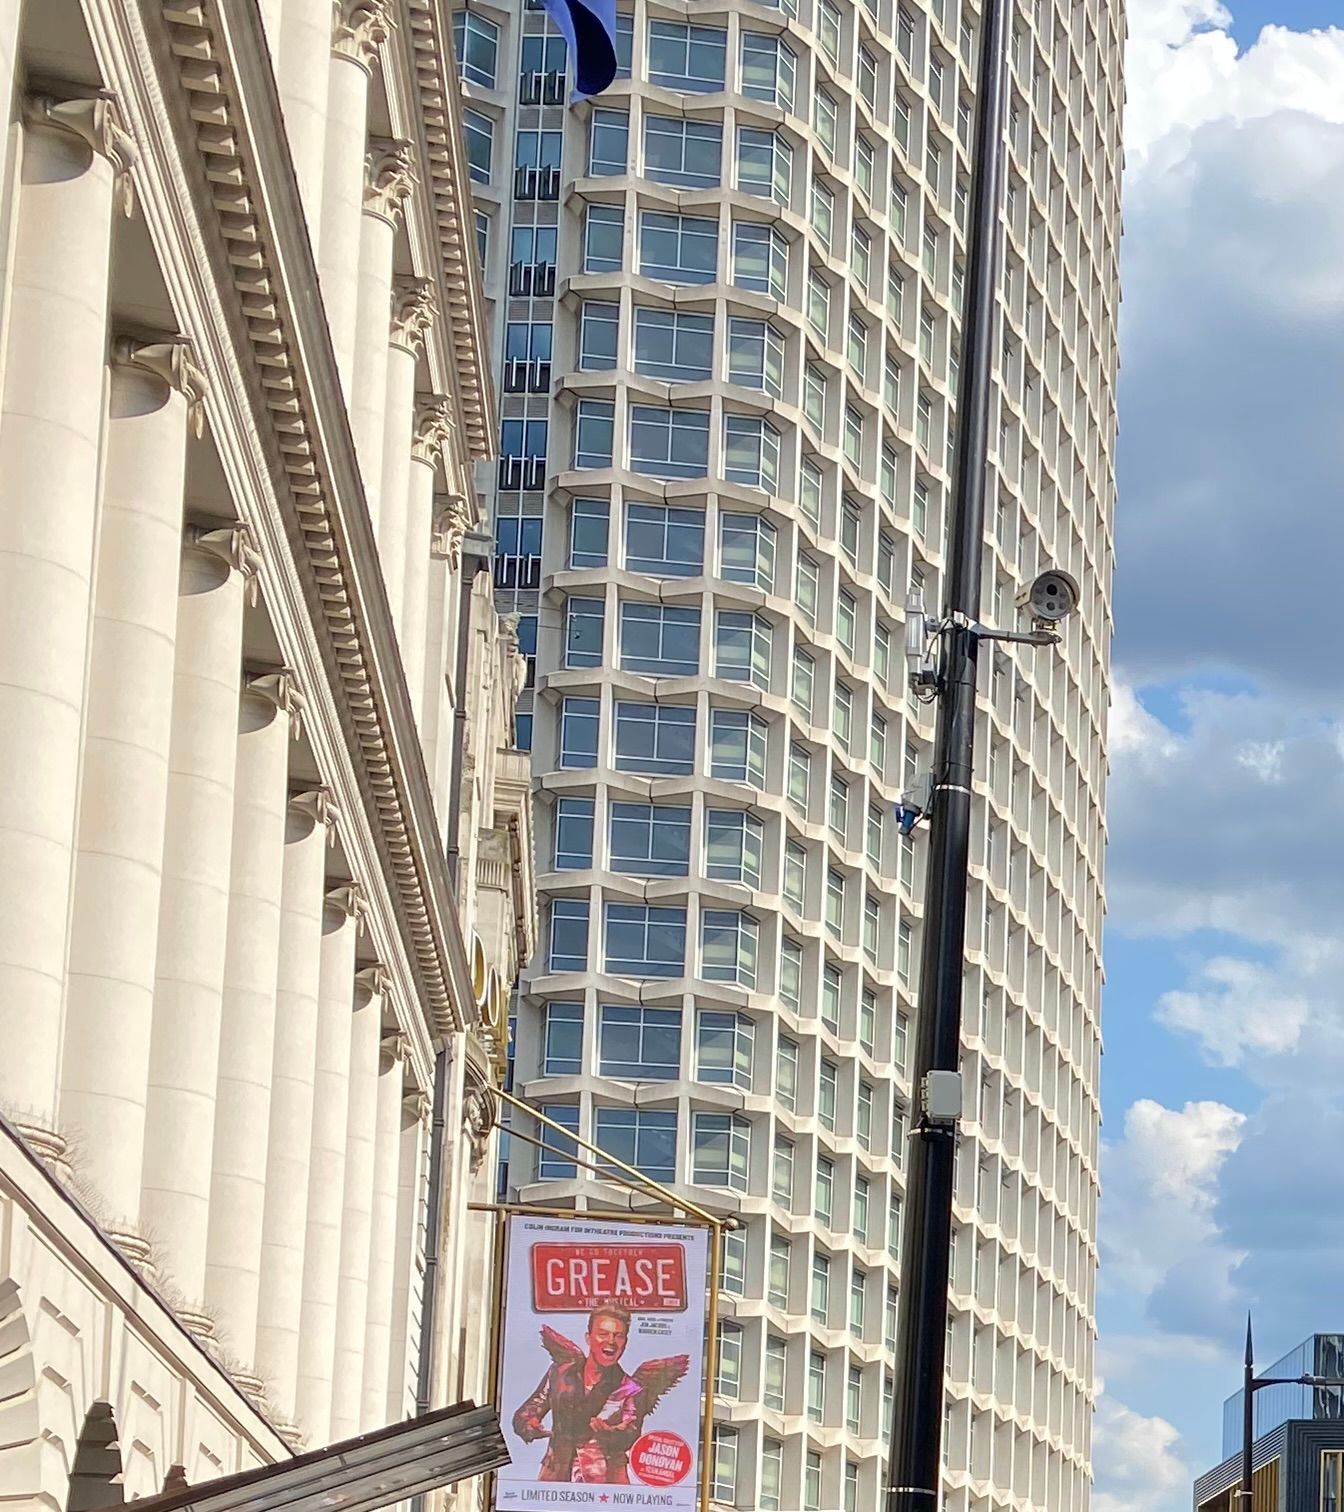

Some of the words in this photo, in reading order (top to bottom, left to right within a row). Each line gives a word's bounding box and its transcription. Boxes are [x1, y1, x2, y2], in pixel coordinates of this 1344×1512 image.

[546, 1259, 676, 1296] GREASE
[649, 1441, 679, 1459] JASON
[638, 1454, 684, 1471] DONOVAN
[521, 1489, 558, 1502] LIMITED
[559, 1491, 595, 1503] SEASON
[613, 1493, 634, 1505] NOW
[635, 1494, 673, 1506] PLAYING
